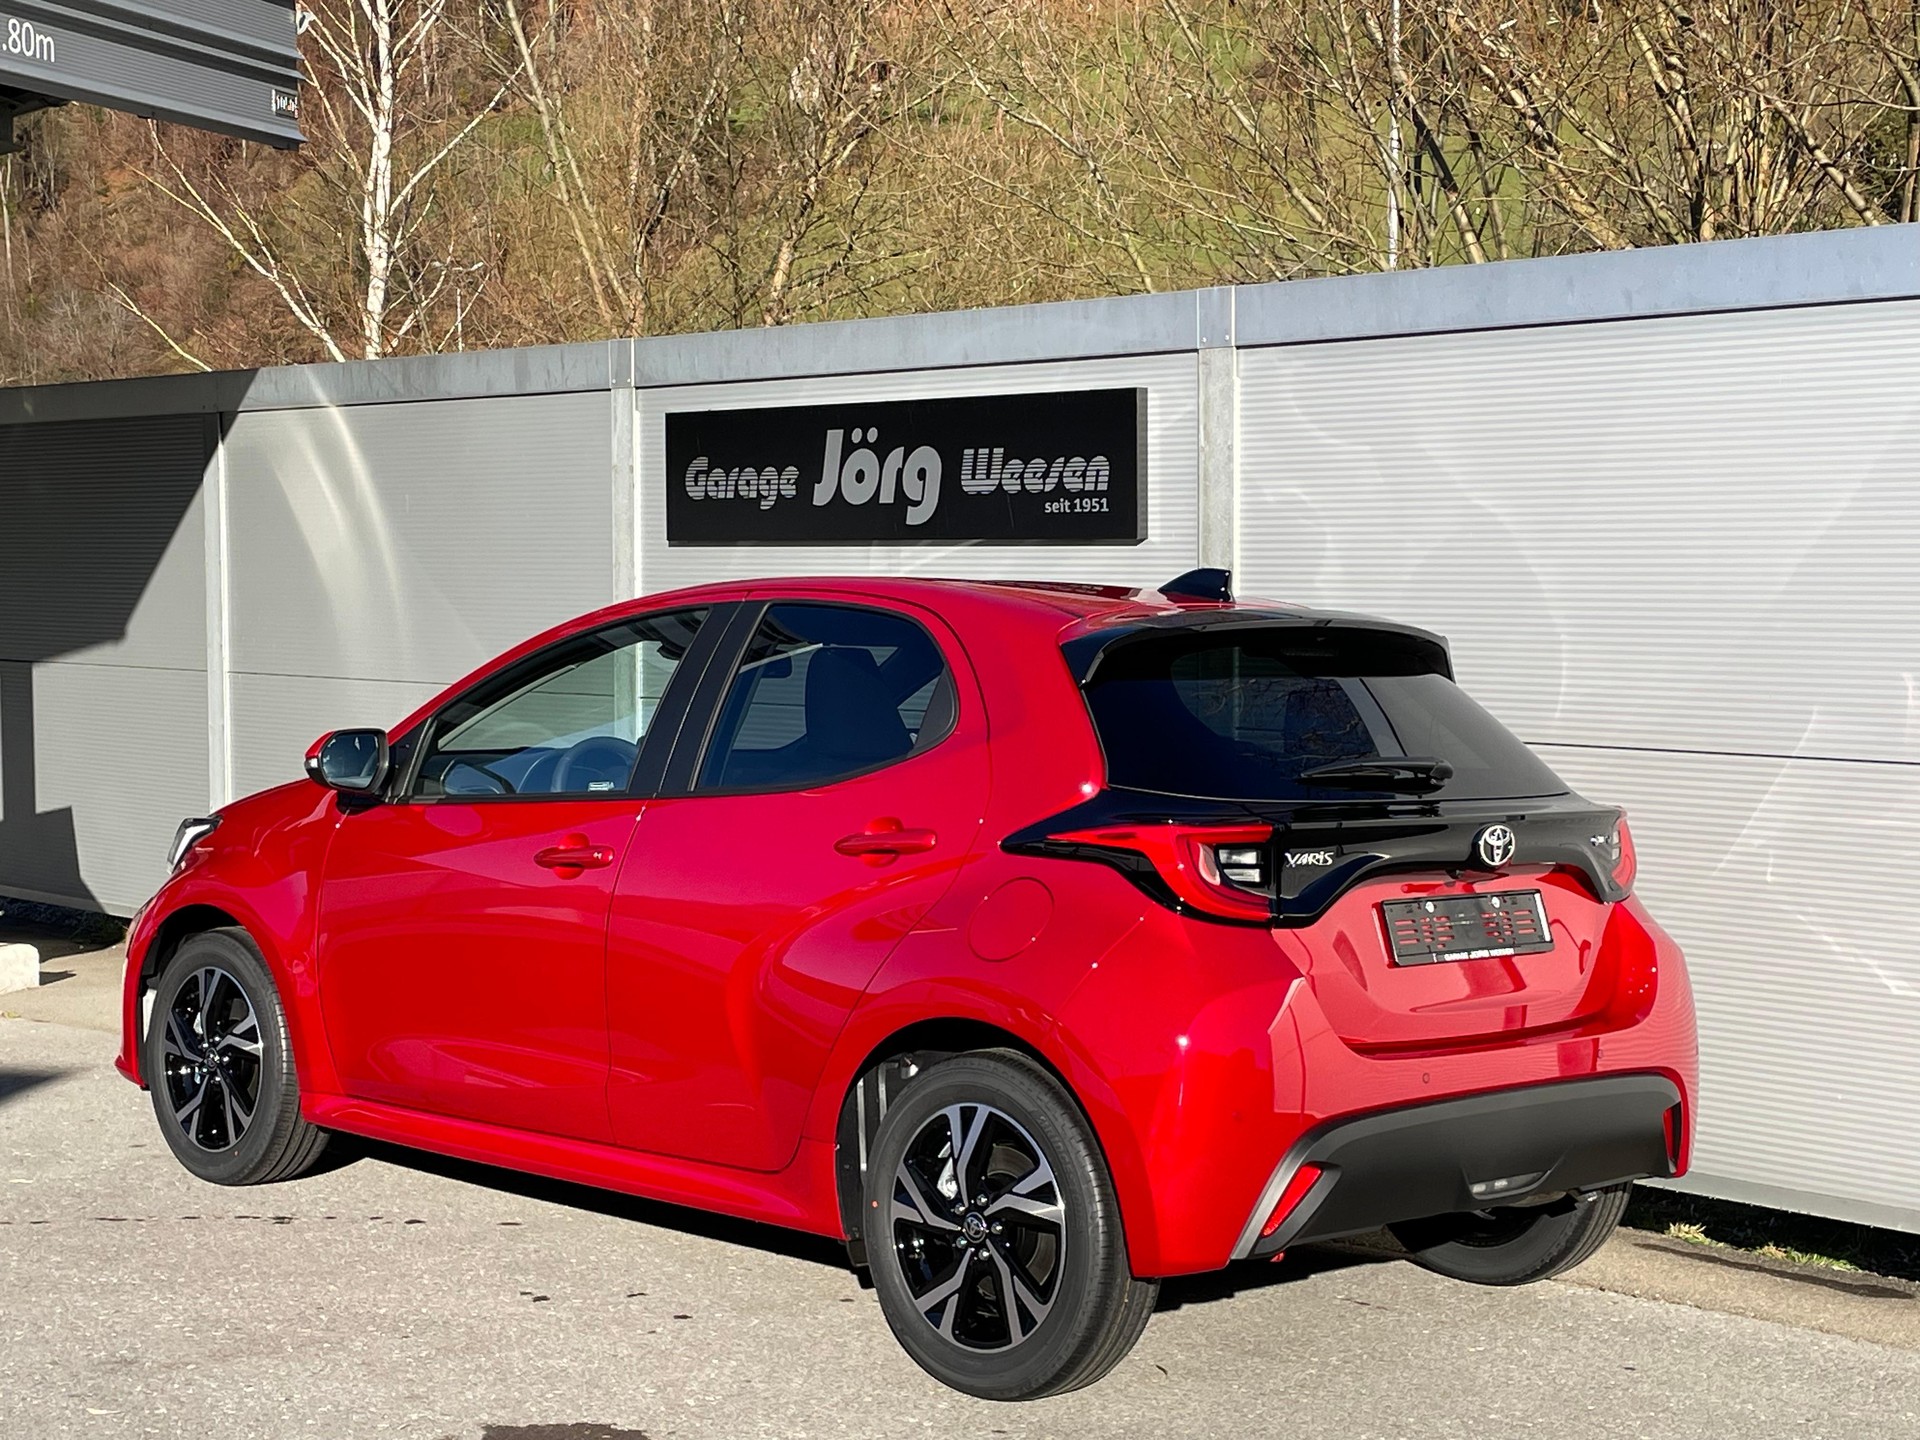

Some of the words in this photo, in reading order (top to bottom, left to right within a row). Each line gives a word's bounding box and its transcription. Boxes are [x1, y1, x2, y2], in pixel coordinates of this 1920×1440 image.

[685, 456, 799, 510] Garage
[812, 427, 942, 525] Jörg
[961, 447, 1110, 495] Weesen
[1044, 497, 1071, 513] seit
[1073, 497, 1110, 513] 1951
